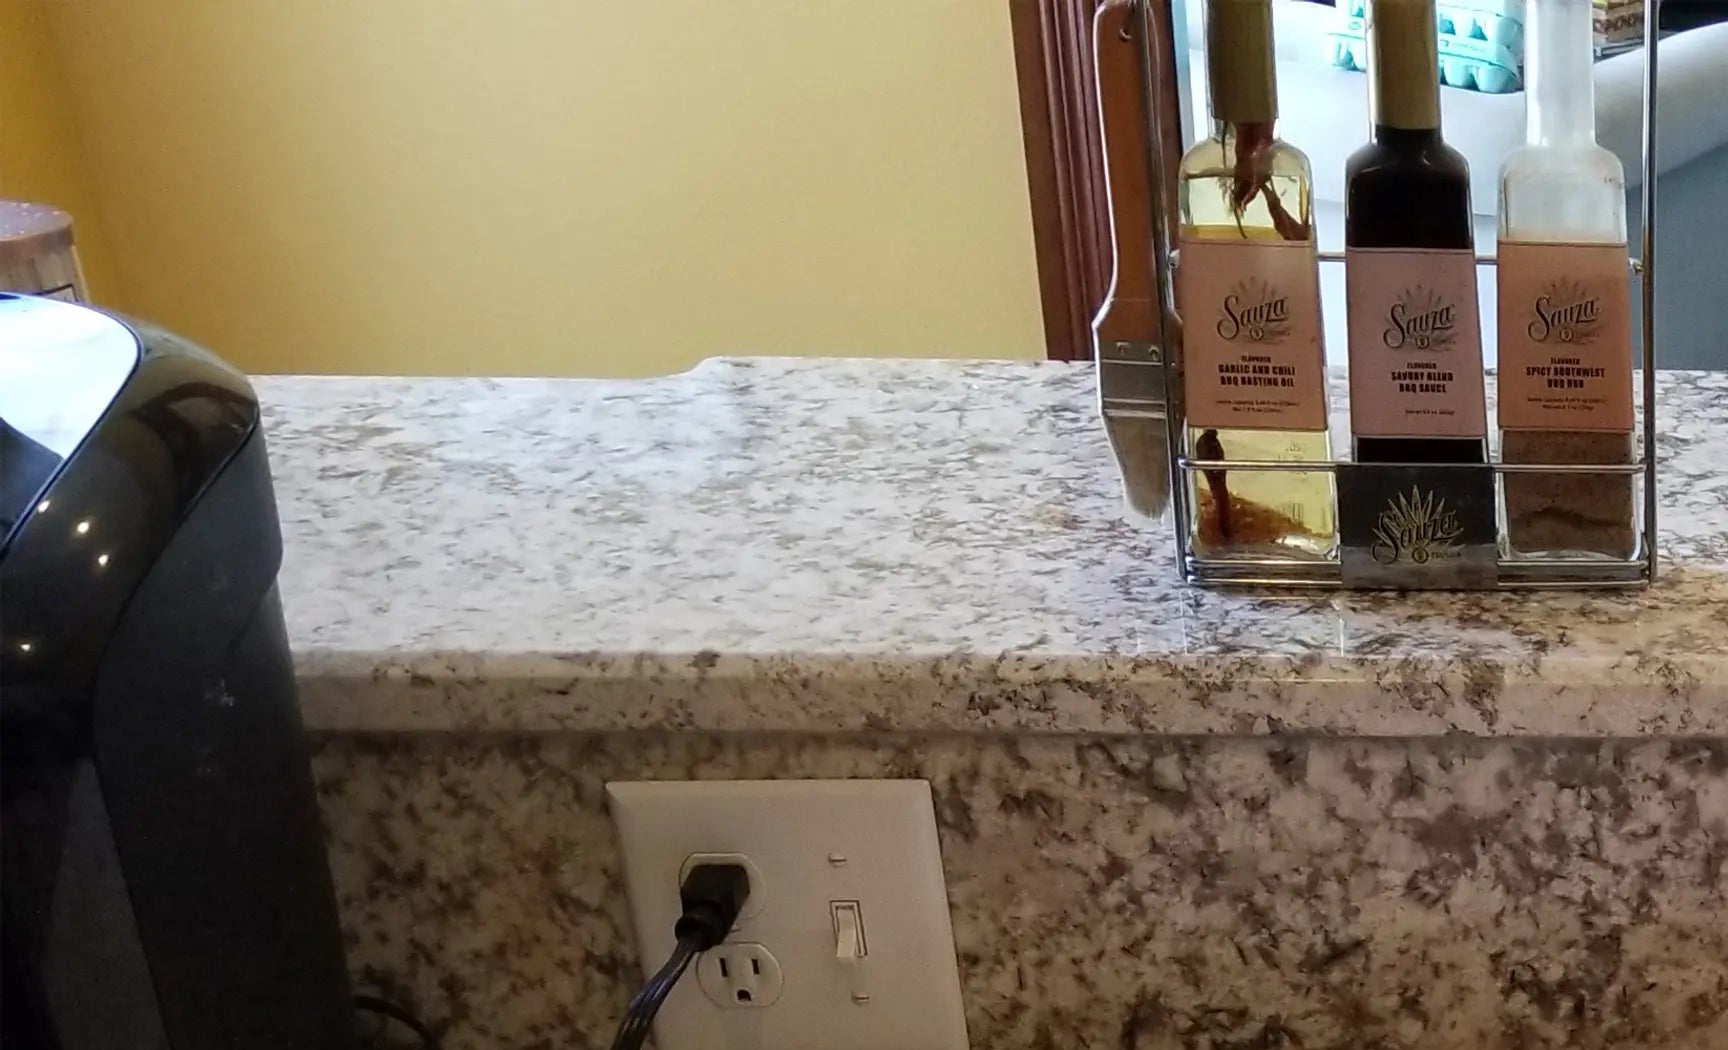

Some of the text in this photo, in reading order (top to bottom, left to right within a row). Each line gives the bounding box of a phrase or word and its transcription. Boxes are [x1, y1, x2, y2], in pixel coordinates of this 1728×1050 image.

[1217, 295, 1289, 341] Sauza
[1383, 303, 1455, 349] Sauza
[1528, 296, 1599, 342] Sauza
[1391, 371, 1425, 381] SAVORY
[1526, 366, 1606, 378] SPICY SOUTHWEST
[1419, 383, 1447, 393] SAUCE
